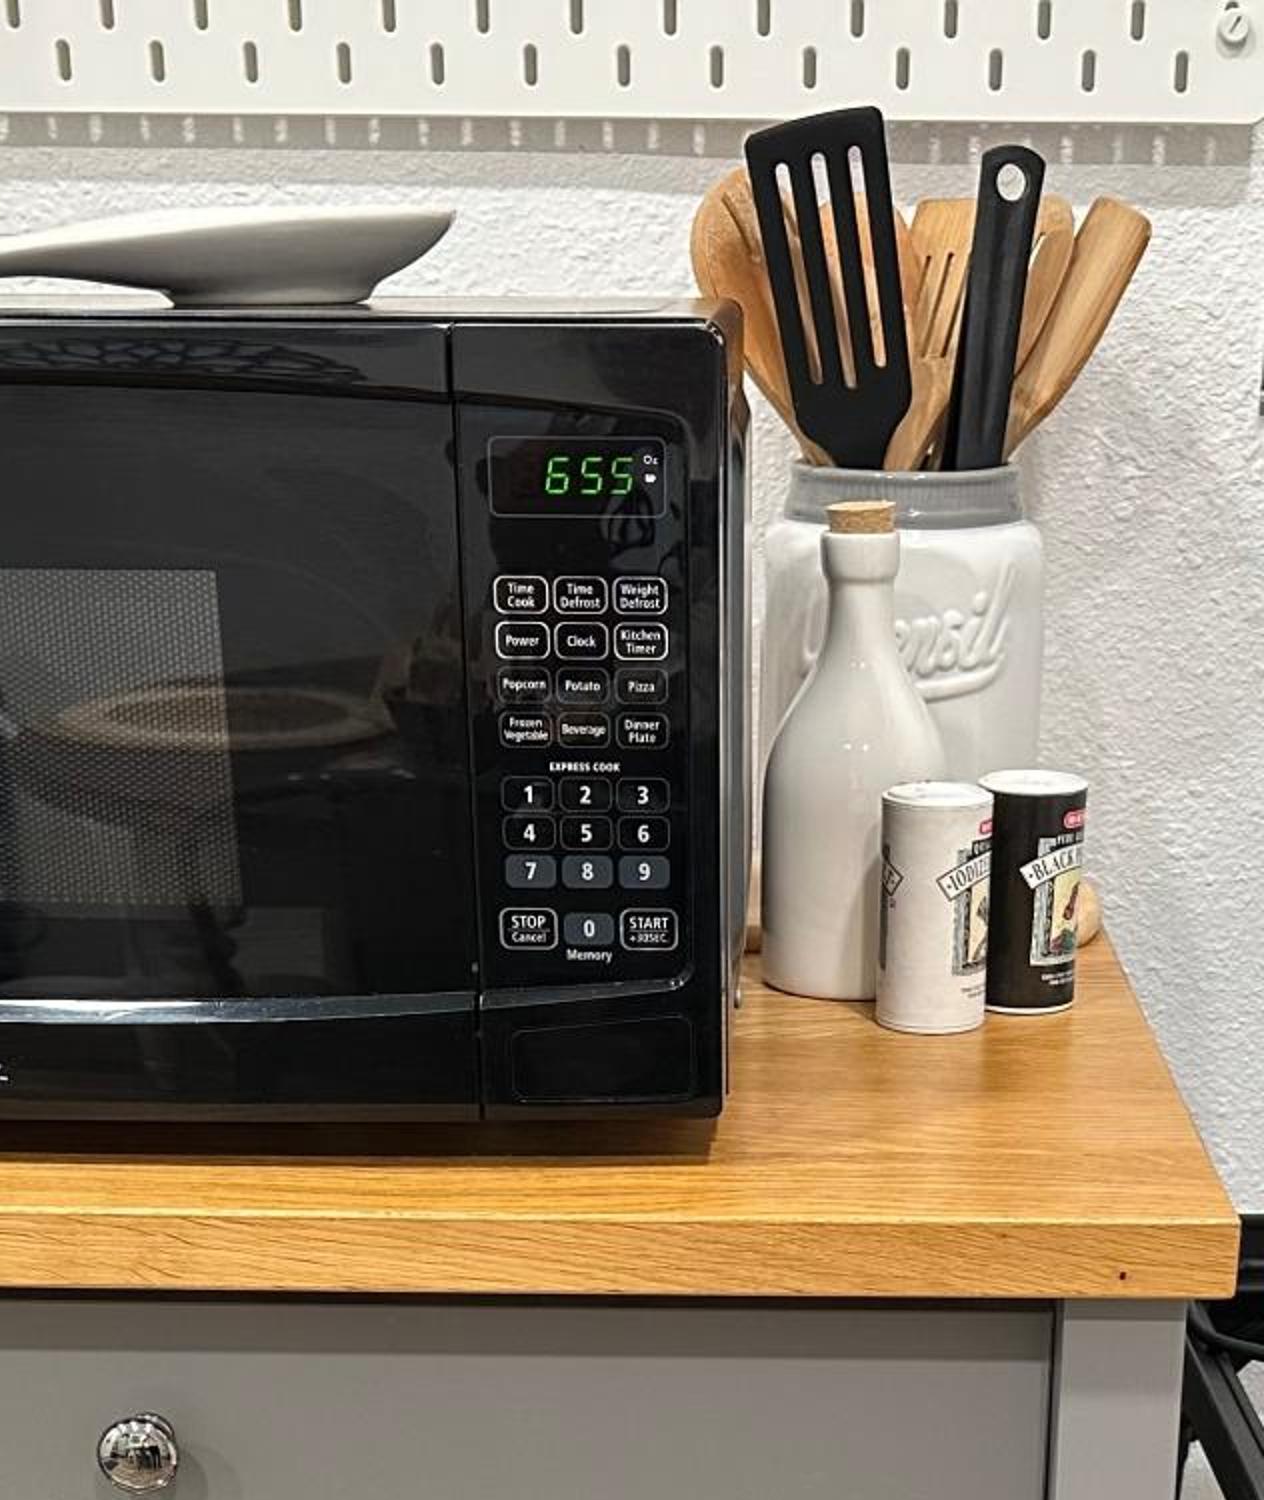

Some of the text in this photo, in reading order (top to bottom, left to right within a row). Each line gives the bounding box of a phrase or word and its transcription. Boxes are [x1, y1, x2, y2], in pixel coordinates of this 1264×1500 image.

[545, 457, 634, 495] 655
[508, 582, 535, 594] Time
[567, 583, 593, 595] Time
[620, 584, 659, 598] Weight
[507, 595, 535, 608] Cook
[560, 595, 600, 609] Defrost
[620, 597, 660, 609] Defrost
[505, 635, 539, 647] Power
[567, 635, 596, 648] Clock
[621, 629, 661, 641] Kitchen
[626, 642, 657, 655] Timer
[502, 677, 547, 692] Popcorn
[565, 679, 601, 691] Potato
[628, 680, 655, 693] Pizza
[509, 717, 543, 728] Frozen
[624, 719, 660, 730] Dinner
[503, 729, 549, 743] Vegetable
[561, 723, 606, 738] Beverage
[628, 732, 657, 743] Plate
[549, 761, 621, 772] EXPRESS COOK
[523, 785, 534, 804] 1
[579, 785, 592, 805] 2
[637, 785, 650, 805] 3
[523, 823, 536, 843] 4
[581, 823, 593, 843] 5
[637, 824, 651, 844] 6
[524, 861, 537, 880] 7
[581, 862, 594, 881] 8
[638, 862, 651, 881] 9
[949, 855, 991, 891] IODIZ
[511, 915, 546, 929] STOP
[583, 919, 596, 938] 0
[629, 916, 669, 930] START
[511, 932, 546, 943] Cancel
[566, 949, 612, 963] Memory
